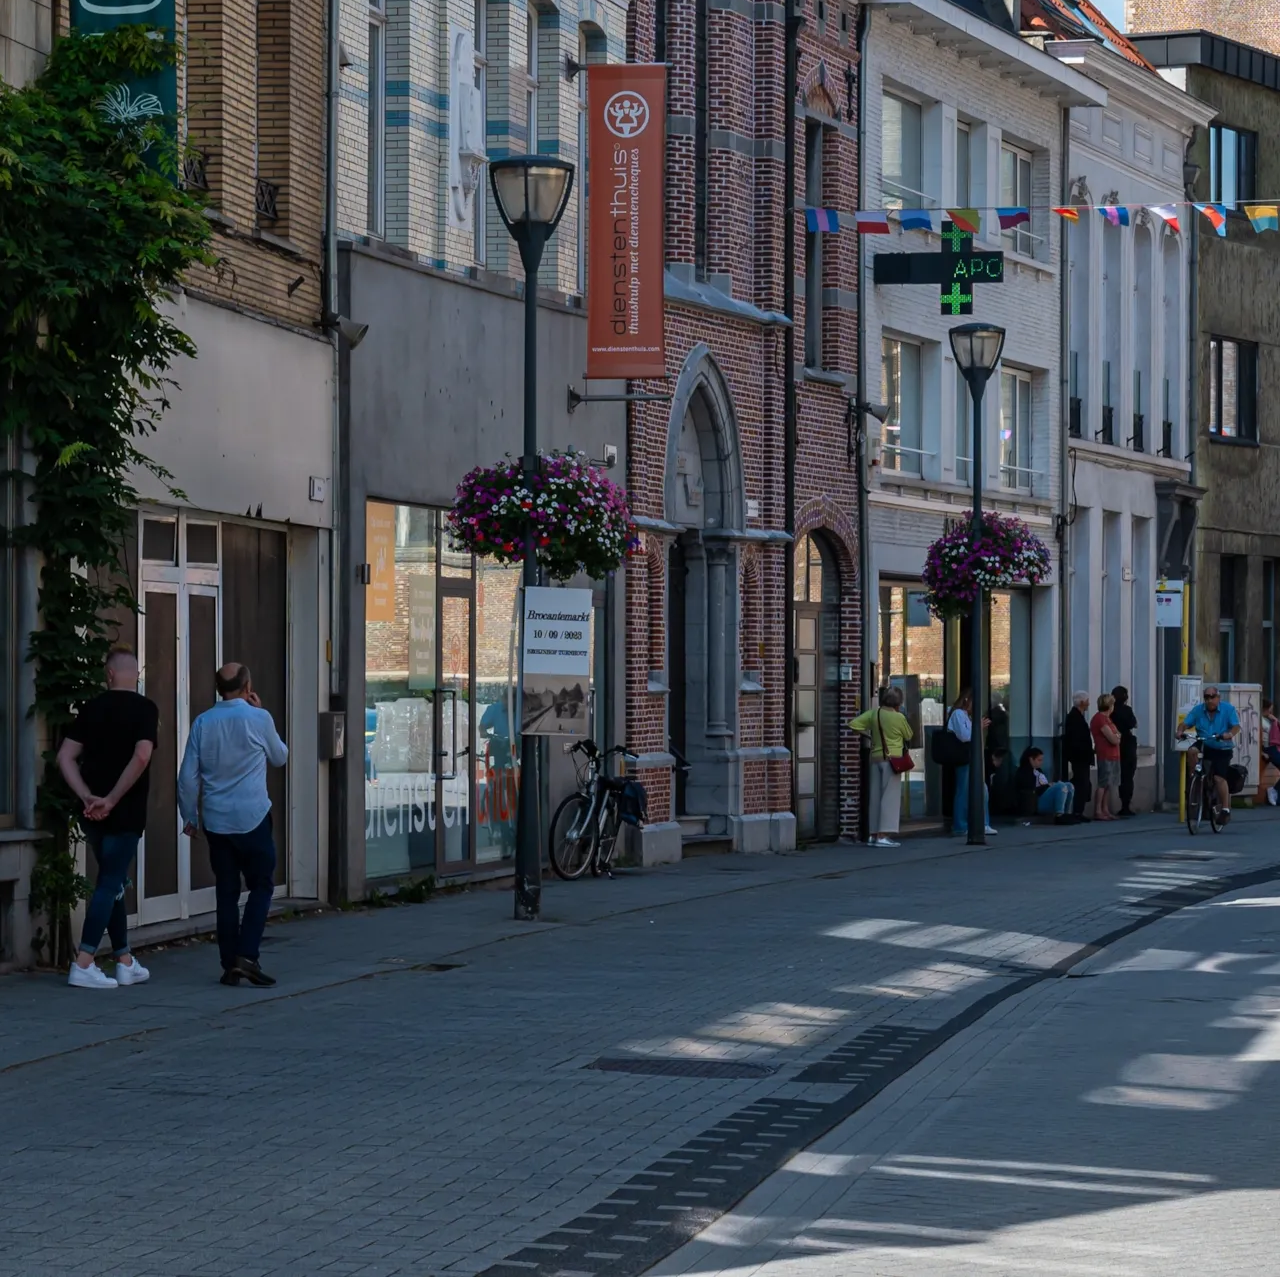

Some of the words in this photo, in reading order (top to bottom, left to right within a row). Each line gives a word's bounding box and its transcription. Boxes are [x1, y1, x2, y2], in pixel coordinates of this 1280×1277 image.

[628, 148, 641, 248] dienstencheques
[609, 149, 628, 335] dienstenthuis
[629, 251, 640, 274] met
[628, 277, 641, 335] thuishulp
[526, 610, 590, 622] Brocantemarkt
